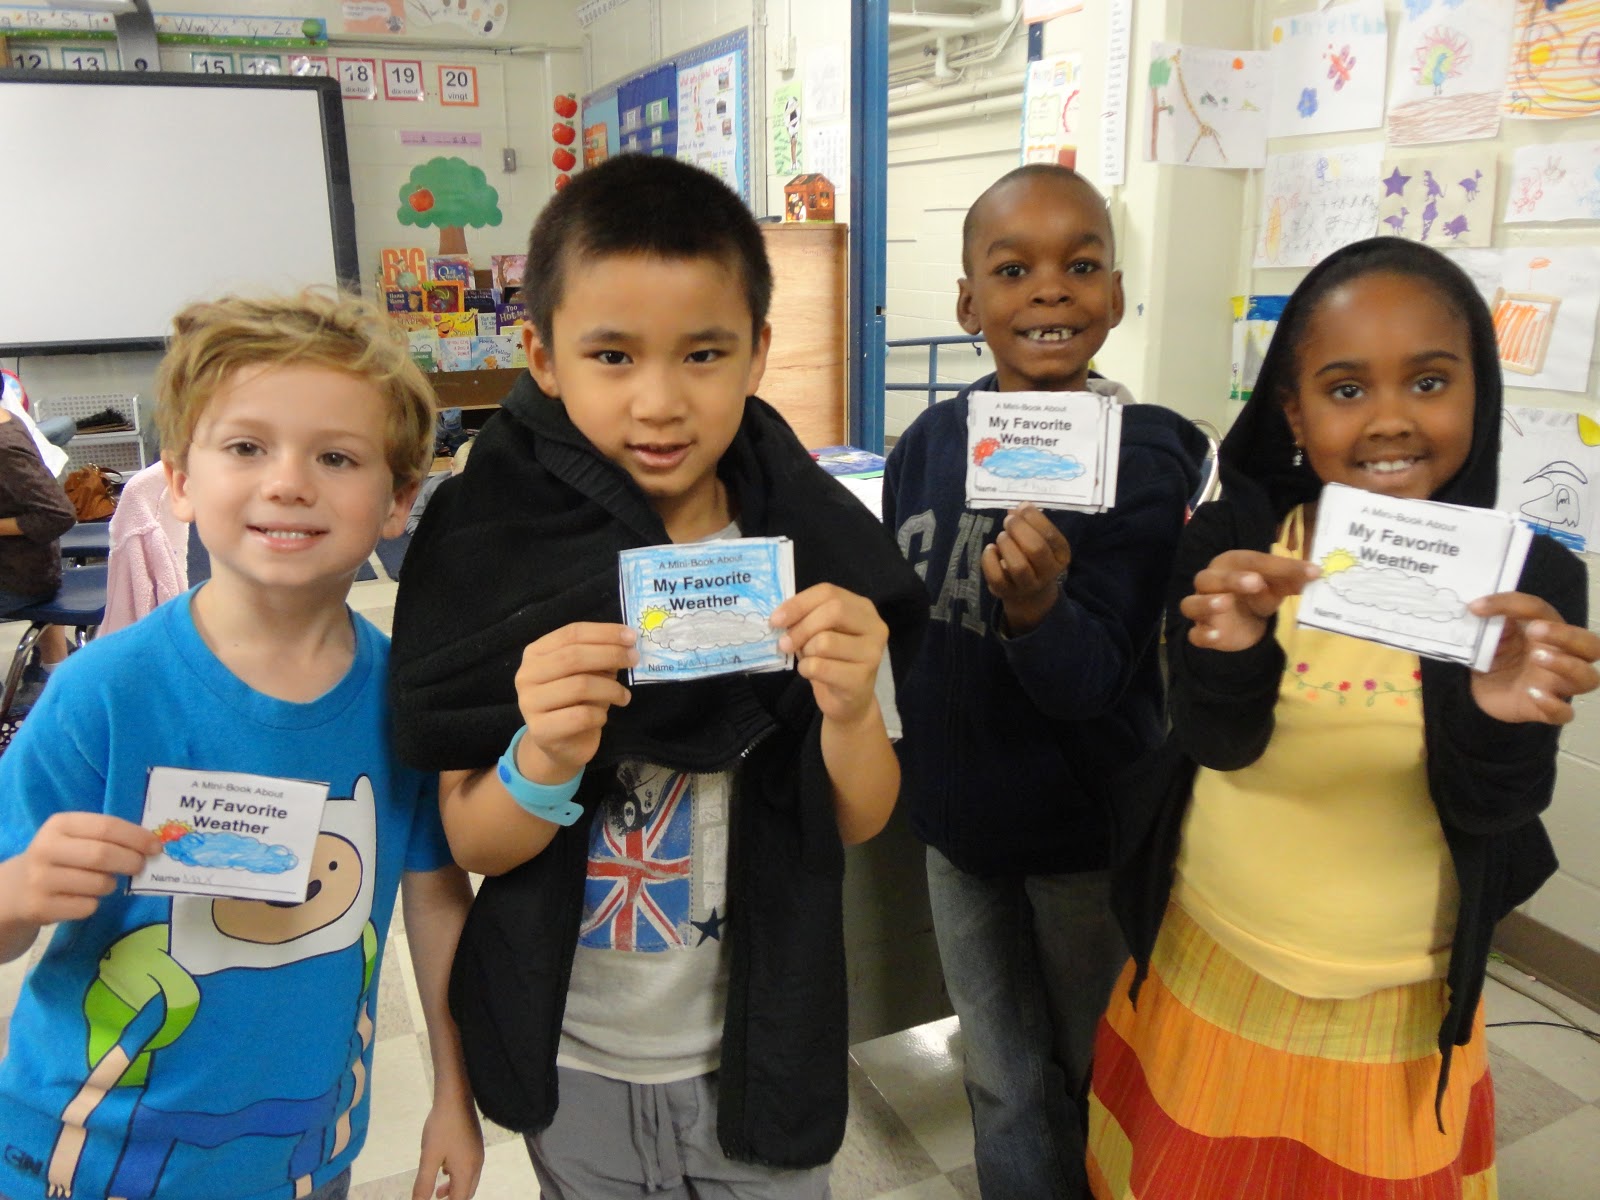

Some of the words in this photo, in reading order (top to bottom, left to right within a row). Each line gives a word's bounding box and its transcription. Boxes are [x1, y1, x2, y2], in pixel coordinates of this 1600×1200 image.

[345, 65, 369, 82] 18
[391, 67, 415, 83] 19
[446, 71, 468, 87] 20
[448, 93, 468, 101] vingt
[500, 311, 516, 323] Hot
[989, 416, 1009, 429] My
[1013, 417, 1072, 431] Favorite
[1000, 433, 1060, 447] Weather
[1348, 521, 1376, 542] My
[1381, 529, 1460, 557] Favorite
[659, 561, 666, 570] A
[717, 554, 743, 564] About
[1359, 545, 1439, 575] Weather
[653, 578, 677, 595] My
[683, 570, 752, 589] Favorite
[669, 593, 740, 611] Weather
[648, 662, 675, 672] Name
[191, 780, 199, 788] A
[254, 787, 284, 799] About
[179, 795, 207, 813] My
[212, 798, 288, 819] Favorite
[192, 815, 269, 835] Weather
[151, 873, 180, 883] Name
